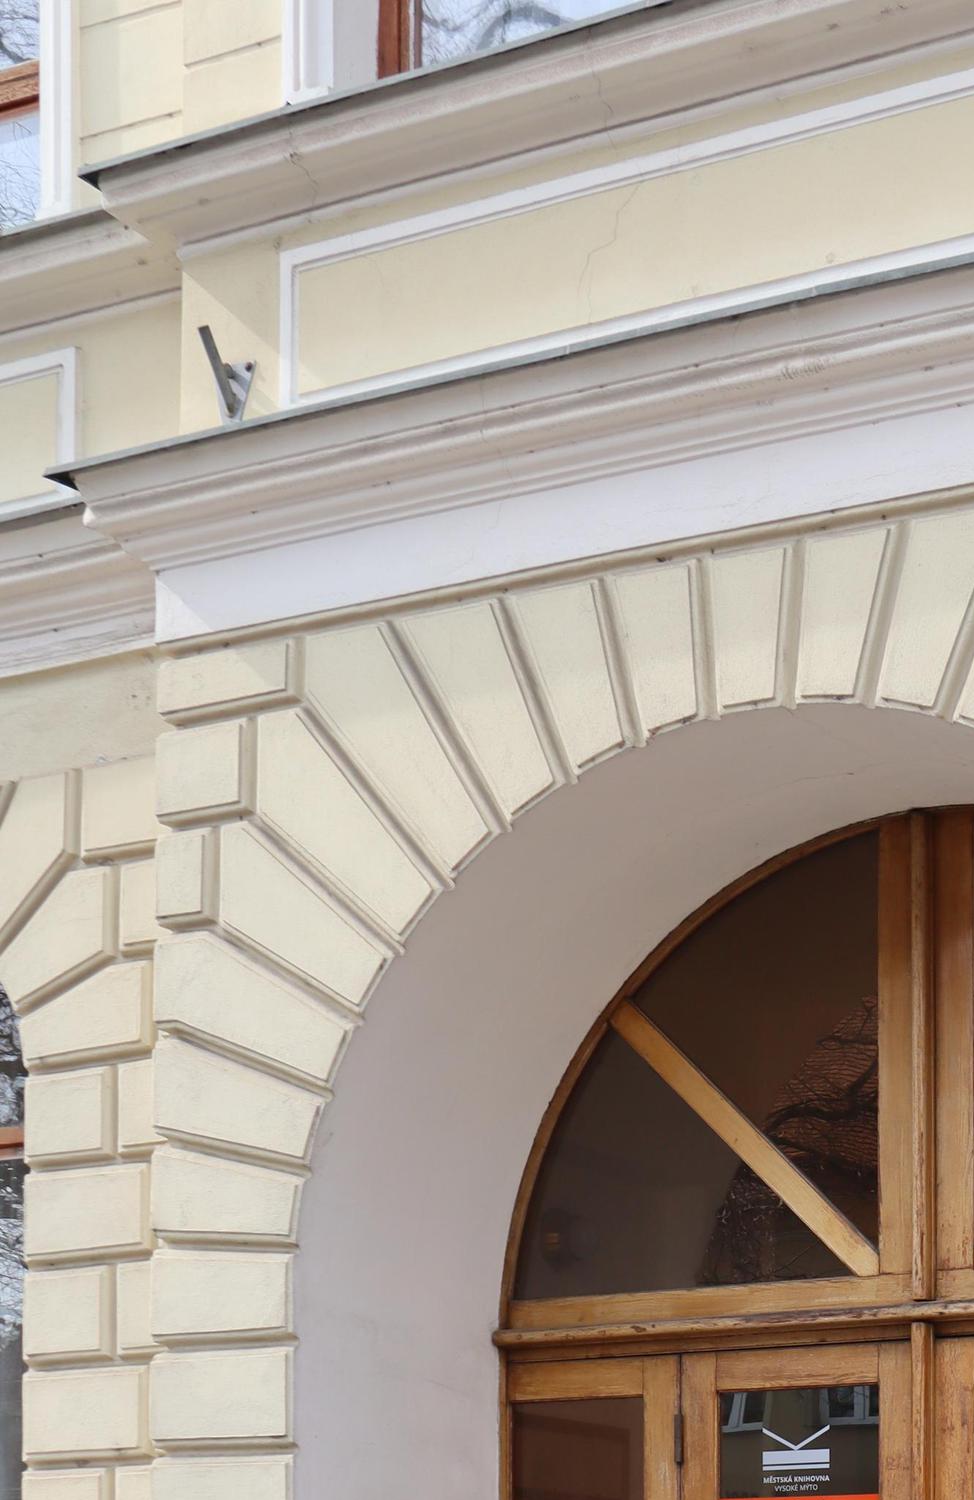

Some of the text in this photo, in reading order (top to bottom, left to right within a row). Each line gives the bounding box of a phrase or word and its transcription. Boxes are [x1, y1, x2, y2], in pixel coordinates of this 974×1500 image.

[763, 1475, 793, 1484] MĚSTSKÁ
[774, 1483, 818, 1492] VYSOKÉ MÝTO
